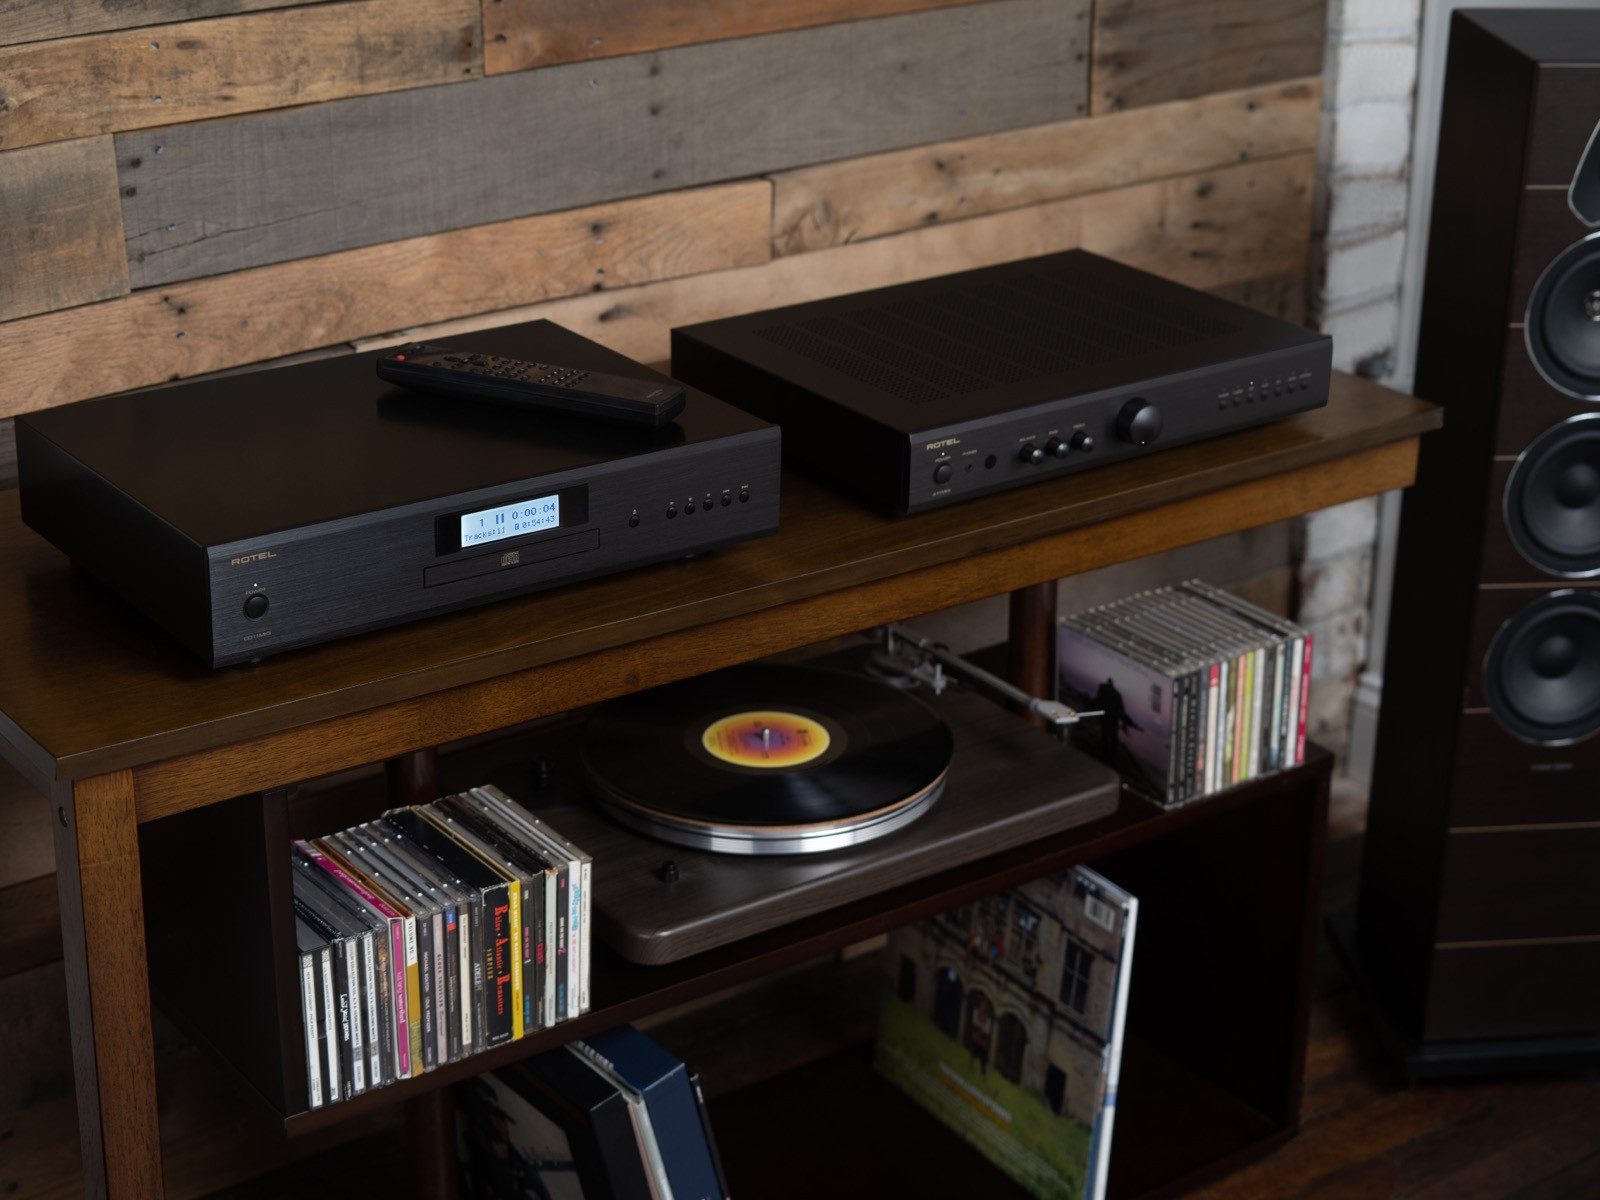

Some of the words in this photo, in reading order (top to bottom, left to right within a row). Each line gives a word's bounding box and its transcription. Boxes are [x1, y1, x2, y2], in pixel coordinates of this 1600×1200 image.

[926, 438, 960, 450] ROTEL
[512, 503, 555, 520] 0:00:04
[231, 551, 277, 566] ROTEL
[495, 903, 508, 931] Rhino
[495, 937, 509, 970] Atlantic
[473, 962, 481, 986] ADELE
[497, 974, 510, 1015] Remasters
